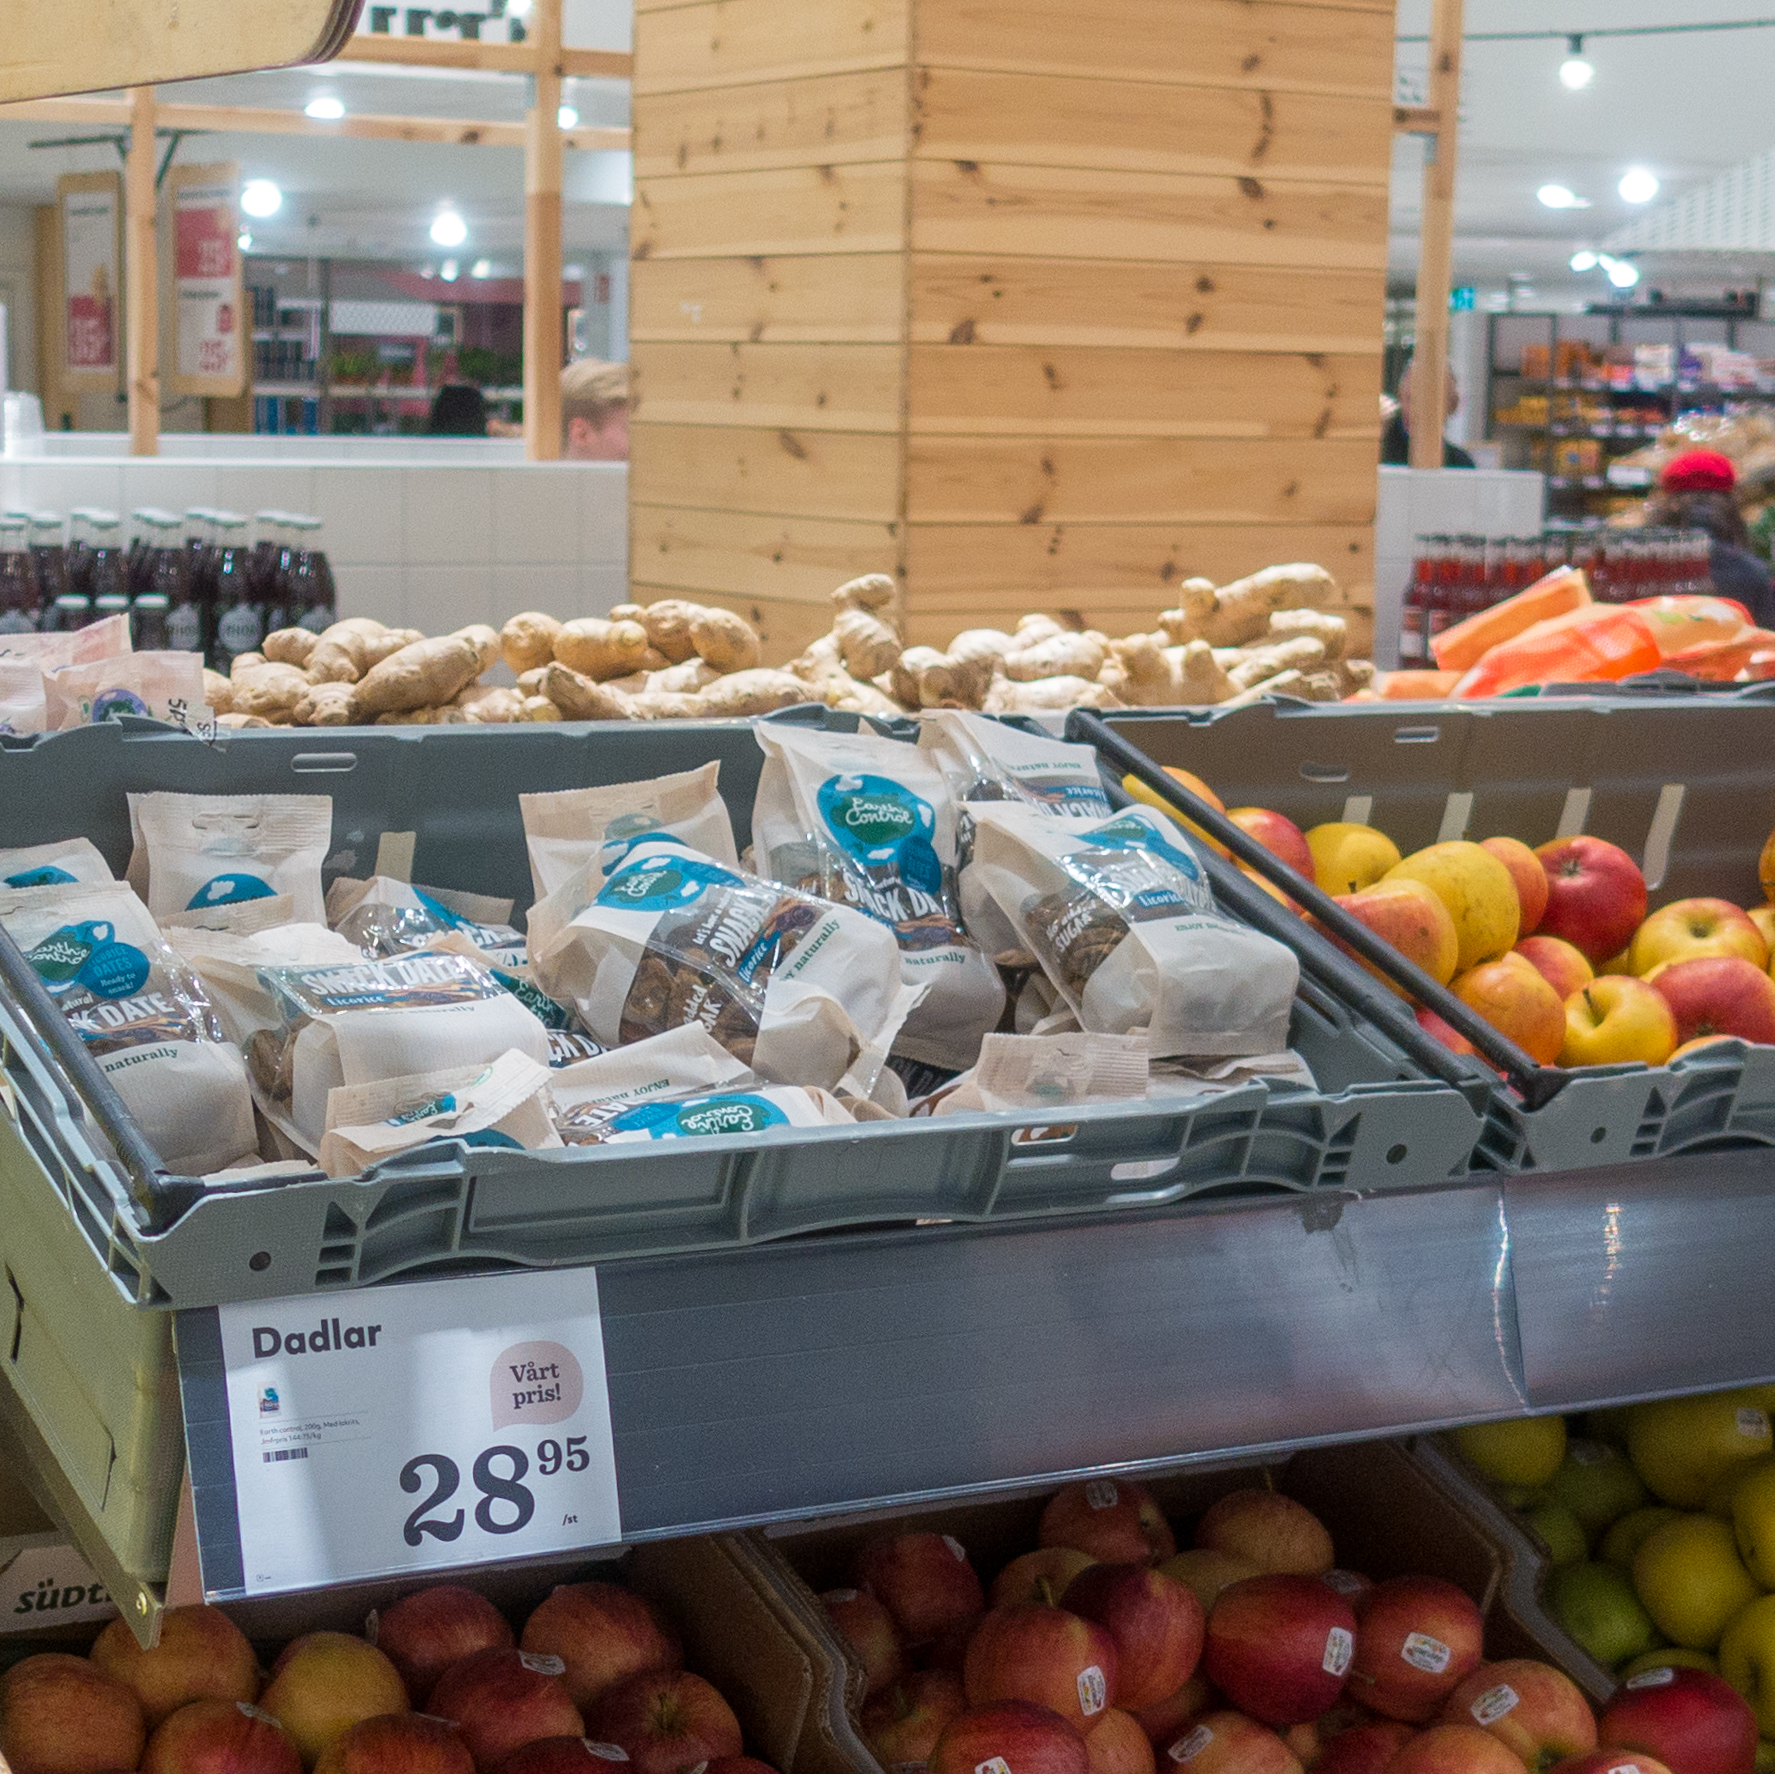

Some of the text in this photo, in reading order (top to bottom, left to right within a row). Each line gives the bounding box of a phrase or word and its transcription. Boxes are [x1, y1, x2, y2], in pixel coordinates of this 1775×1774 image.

[844, 873, 909, 921] SNACK
[794, 919, 841, 971] naturally
[97, 993, 176, 1027] DATE
[105, 1048, 179, 1074] naturally
[252, 1318, 382, 1358] Dadlar
[510, 1361, 560, 1383] Vårt
[512, 1383, 562, 1410] pris!
[399, 1436, 590, 1547] 28 95
[562, 1514, 578, 1526] /st
